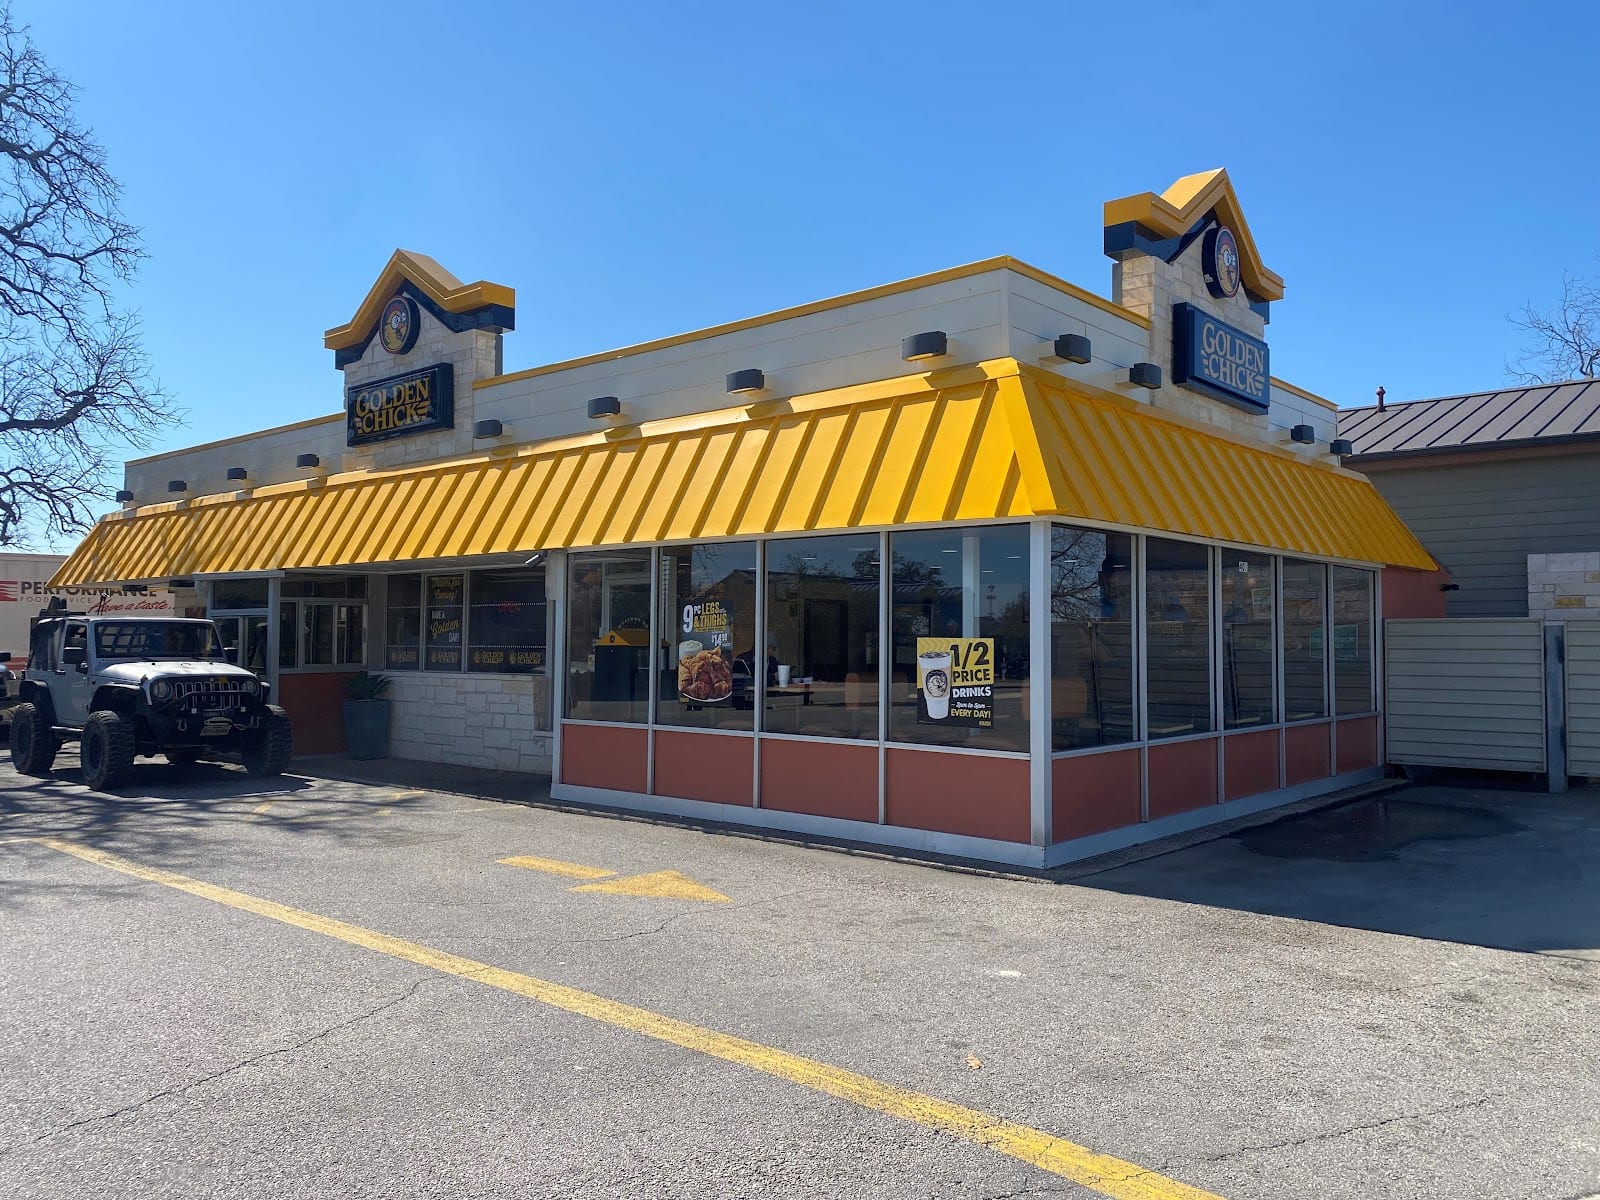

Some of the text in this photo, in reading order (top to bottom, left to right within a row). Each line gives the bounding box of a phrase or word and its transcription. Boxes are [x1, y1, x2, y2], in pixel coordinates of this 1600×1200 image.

[1202, 322, 1265, 375] GOLDEN
[1208, 355, 1260, 396] CHICK
[355, 376, 430, 418] GOLDEN
[361, 402, 421, 434] CHICK
[88, 599, 123, 613] Have
[125, 602, 134, 611] a
[683, 604, 694, 633] 9
[694, 605, 702, 615] PC
[702, 602, 720, 615] LEGS
[700, 613, 727, 627] THIGHS
[950, 642, 989, 669] 1/2
[953, 669, 990, 682] PRICE
[952, 686, 992, 698] DRINKS
[950, 708, 991, 719] EVERY DAY!
